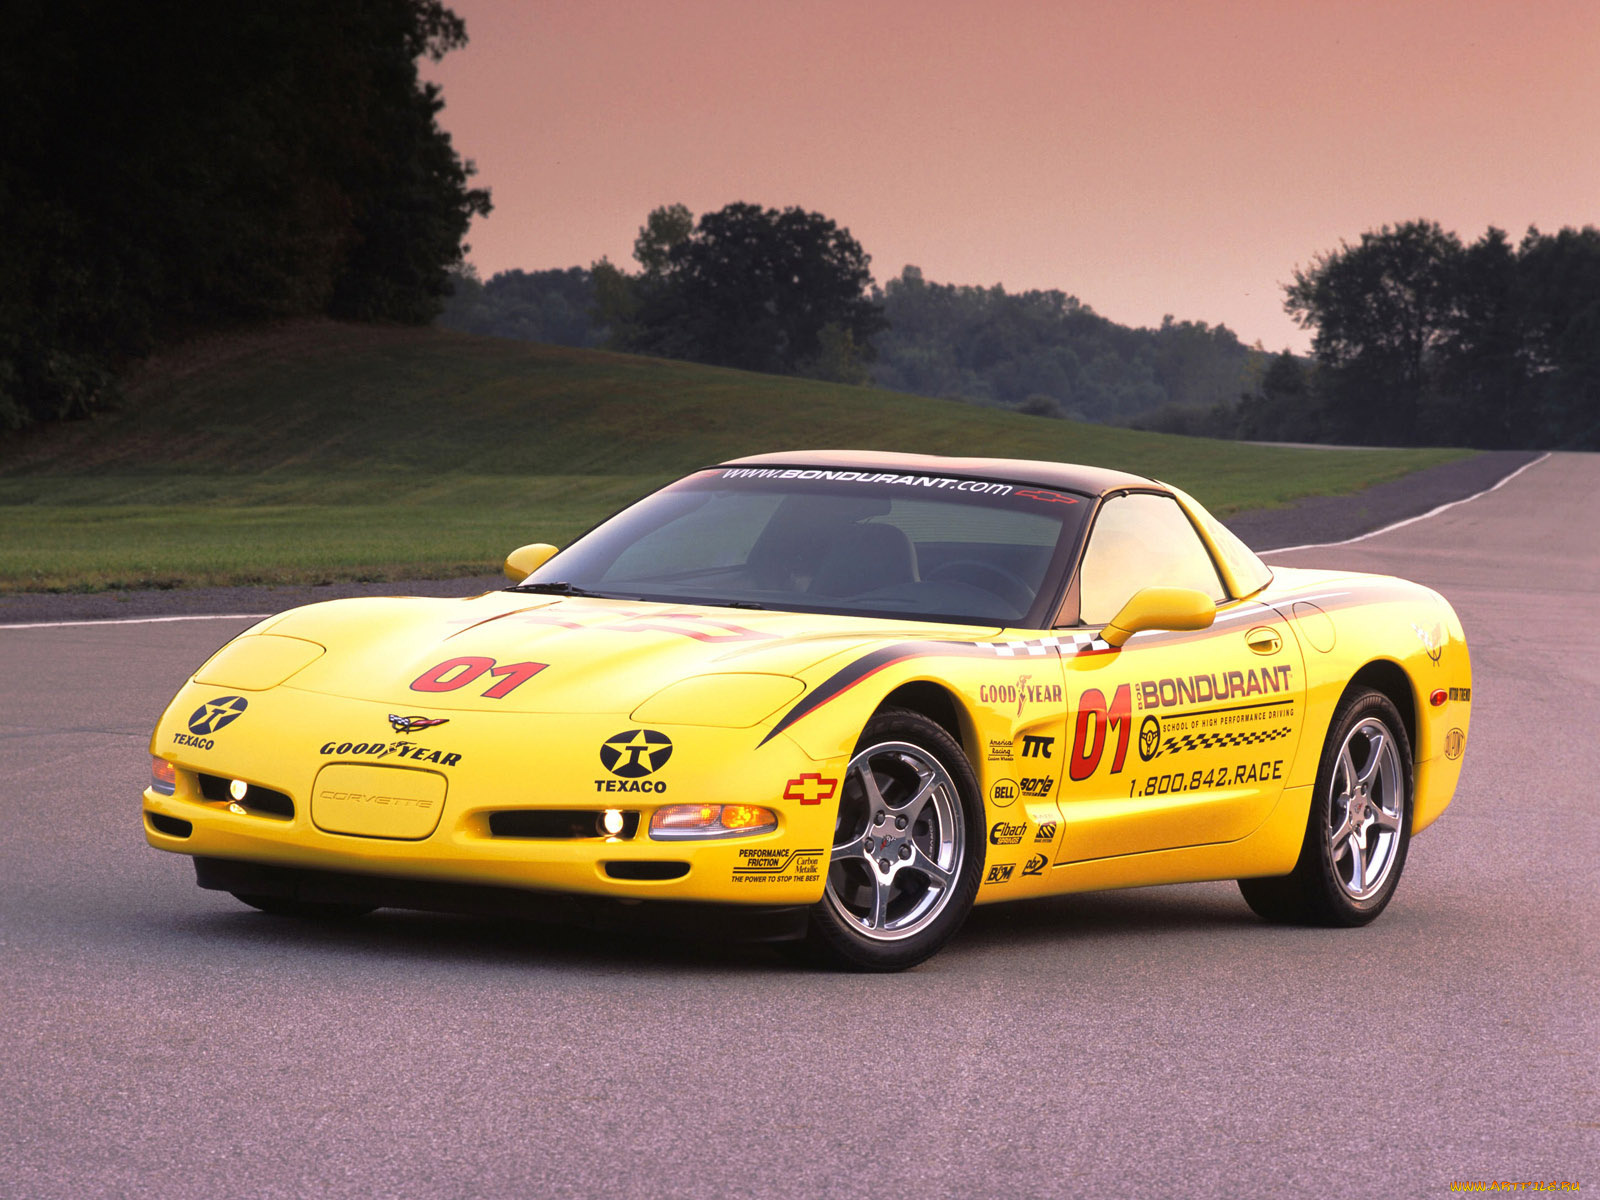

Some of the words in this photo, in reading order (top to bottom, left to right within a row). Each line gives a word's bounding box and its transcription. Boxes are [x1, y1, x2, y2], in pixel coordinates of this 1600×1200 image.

[722, 469, 1013, 497] www.BONDURANT.com
[409, 656, 550, 699] 01
[1141, 665, 1291, 710] BONDURANT
[1163, 721, 1189, 733] SCHOOL
[1191, 720, 1199, 728] OF
[1202, 718, 1218, 727] HIGH
[1220, 712, 1266, 725] PERFORMANCE
[1269, 709, 1294, 719] DRIVING
[173, 733, 214, 750] TEXACO
[1069, 683, 1132, 782] 01
[992, 747, 1011, 757] Racing
[594, 780, 667, 794] TEXACO
[1130, 760, 1283, 798] 1.800.842.RACE
[320, 790, 434, 809] CORVETTE
[994, 786, 1015, 799] BELL
[990, 822, 1027, 845] Eibach
[738, 848, 790, 858] PERFORMANCE
[796, 857, 818, 866] Carbon
[747, 858, 780, 867] FRICTION
[795, 866, 818, 874] Metallic
